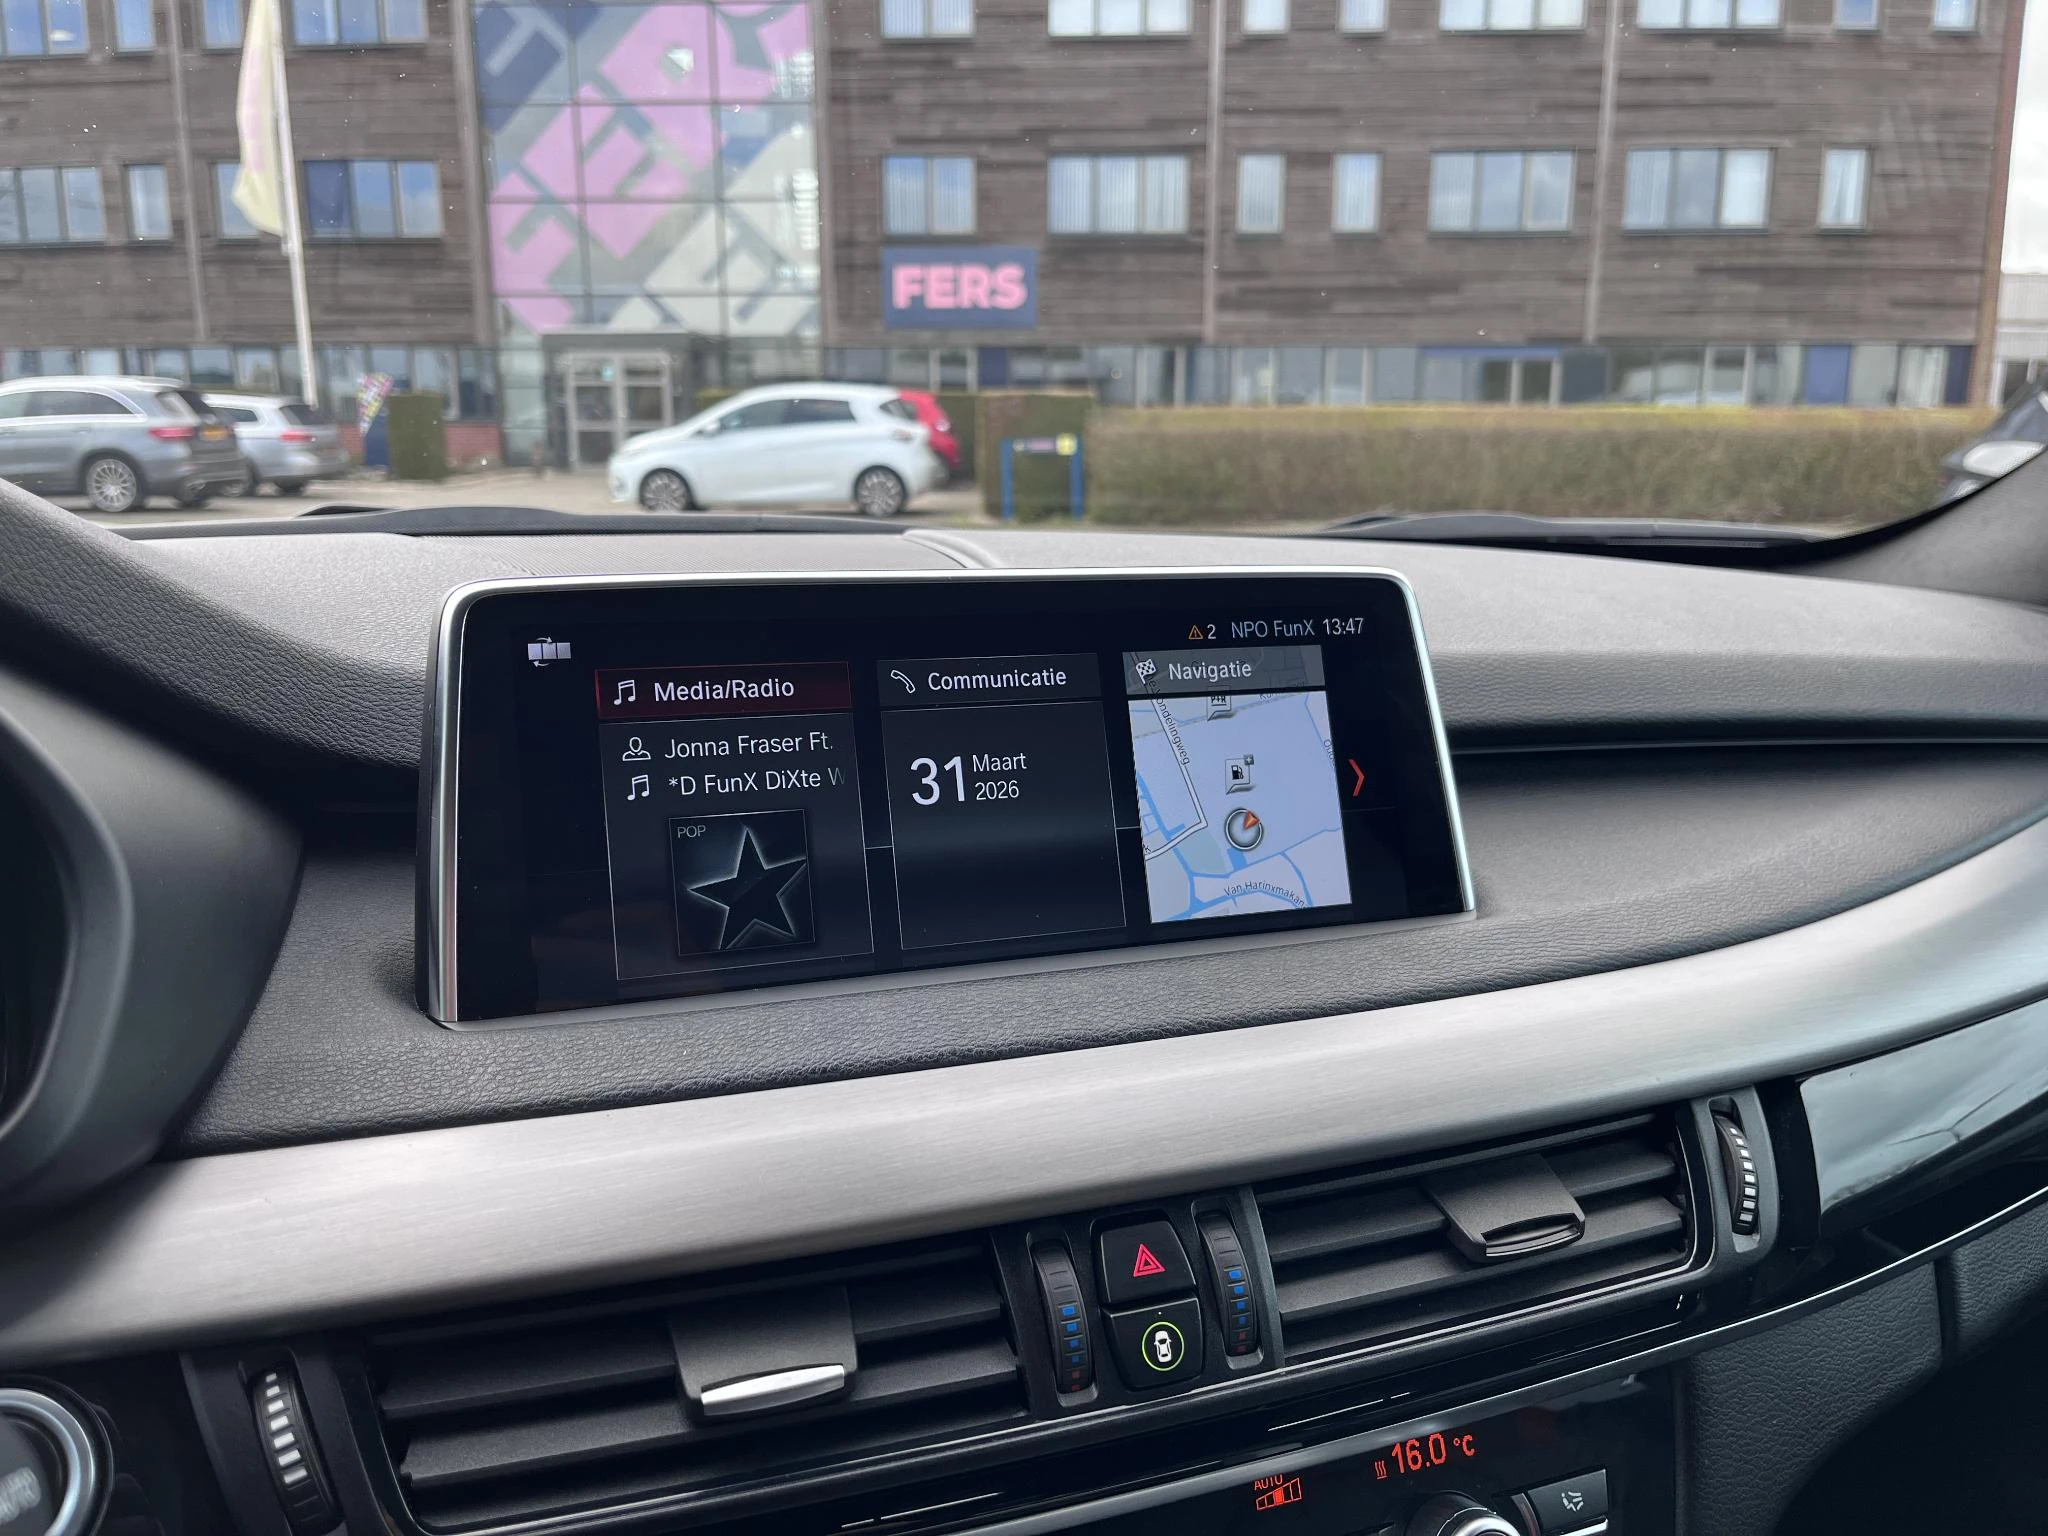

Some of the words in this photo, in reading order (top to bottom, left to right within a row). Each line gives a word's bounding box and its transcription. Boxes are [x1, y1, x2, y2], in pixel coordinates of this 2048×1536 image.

[892, 264, 1027, 309] FERS
[1207, 624, 1217, 640] 2
[1231, 620, 1268, 639] NPO
[1274, 619, 1316, 637] FunX
[1322, 617, 1364, 635] 13:47
[927, 668, 1067, 691] Communicatie
[1168, 661, 1252, 682] Navigatie
[654, 678, 795, 702] Media/Radio
[664, 739, 730, 759] Jonna
[737, 734, 803, 755] Fraser
[972, 753, 1027, 772] Maart
[704, 772, 759, 794] FunX
[766, 769, 821, 790] DiXte
[910, 756, 965, 806] 31
[975, 780, 1020, 801] 2026
[677, 825, 706, 839] POP
[1224, 885, 1242, 896] Van
[1245, 881, 1307, 909] Harinxmakan
[1391, 1432, 1448, 1474] 16.0
[1254, 1474, 1284, 1491] AUTO
